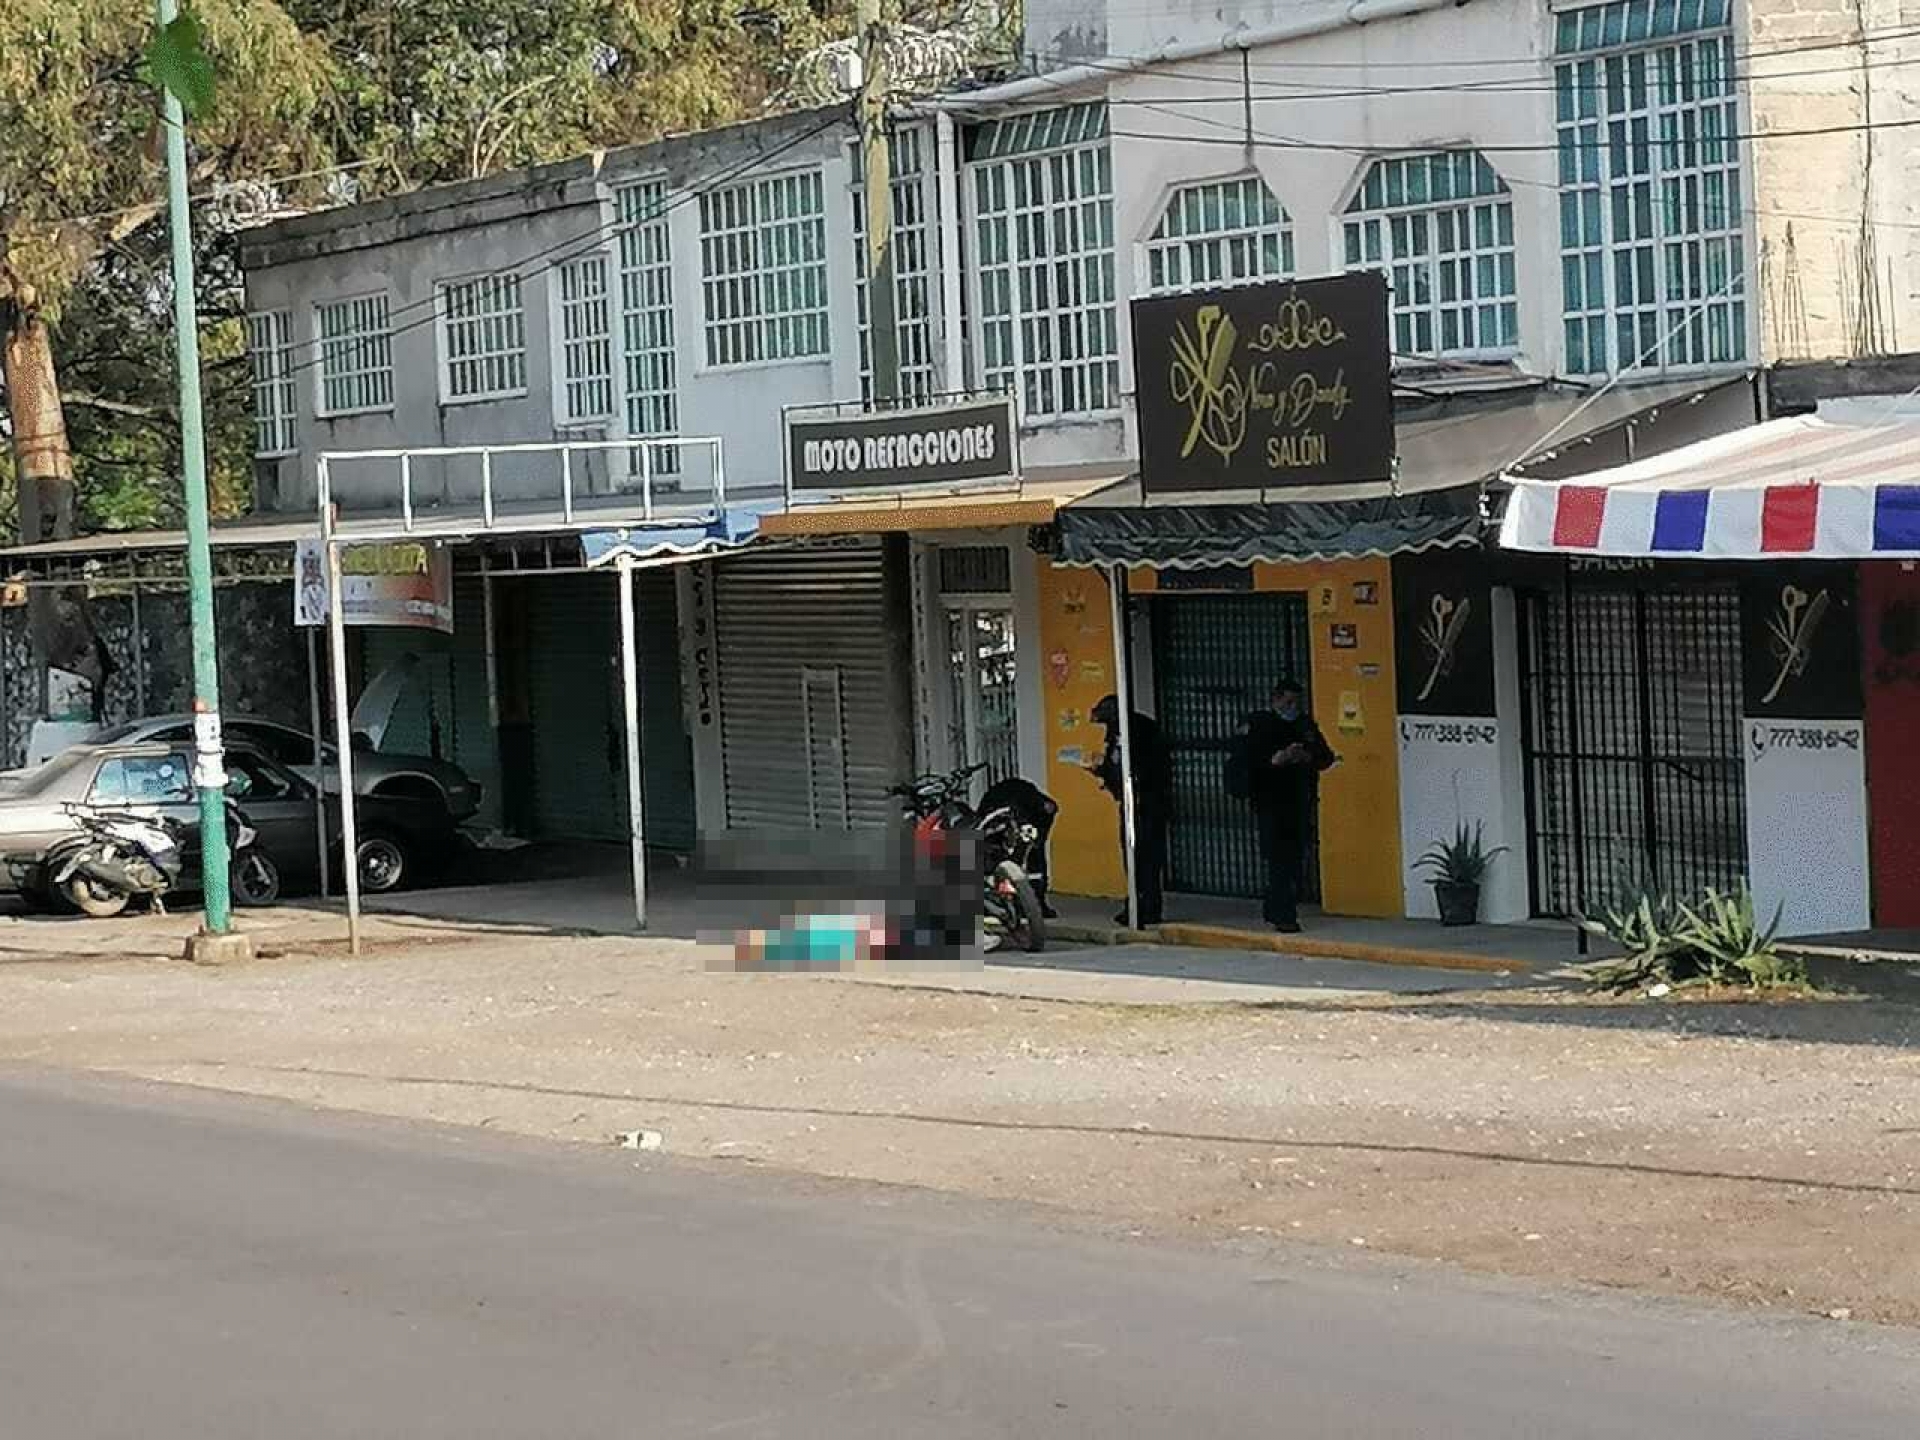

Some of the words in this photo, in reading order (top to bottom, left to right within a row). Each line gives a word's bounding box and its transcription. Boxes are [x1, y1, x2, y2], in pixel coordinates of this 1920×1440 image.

[803, 437, 861, 473] MOTO
[863, 422, 996, 470] REFACCIONES
[1266, 427, 1328, 469] SALÓN
